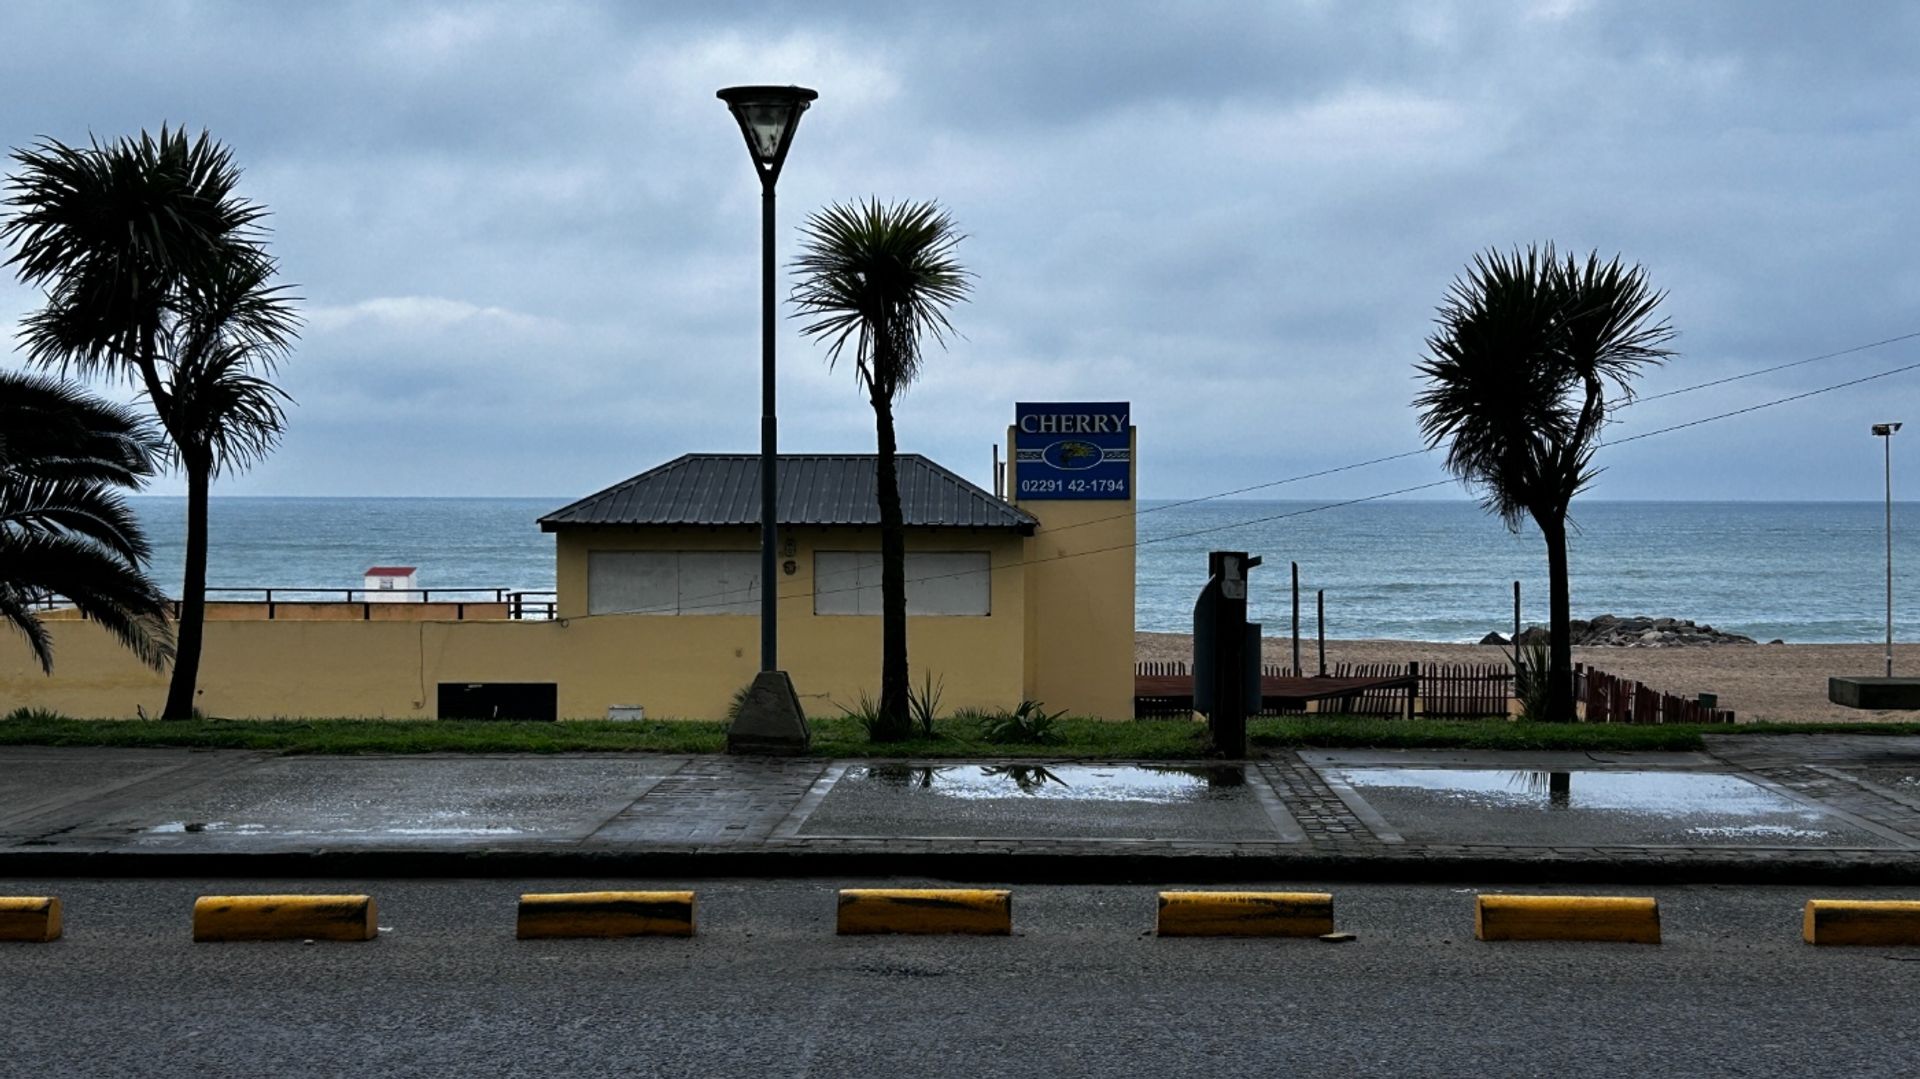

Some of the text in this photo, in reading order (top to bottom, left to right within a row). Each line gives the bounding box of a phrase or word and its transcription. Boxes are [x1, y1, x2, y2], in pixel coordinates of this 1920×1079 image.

[1020, 414, 1127, 433] CHERRY
[1021, 480, 1125, 492] 02291 42-1794
